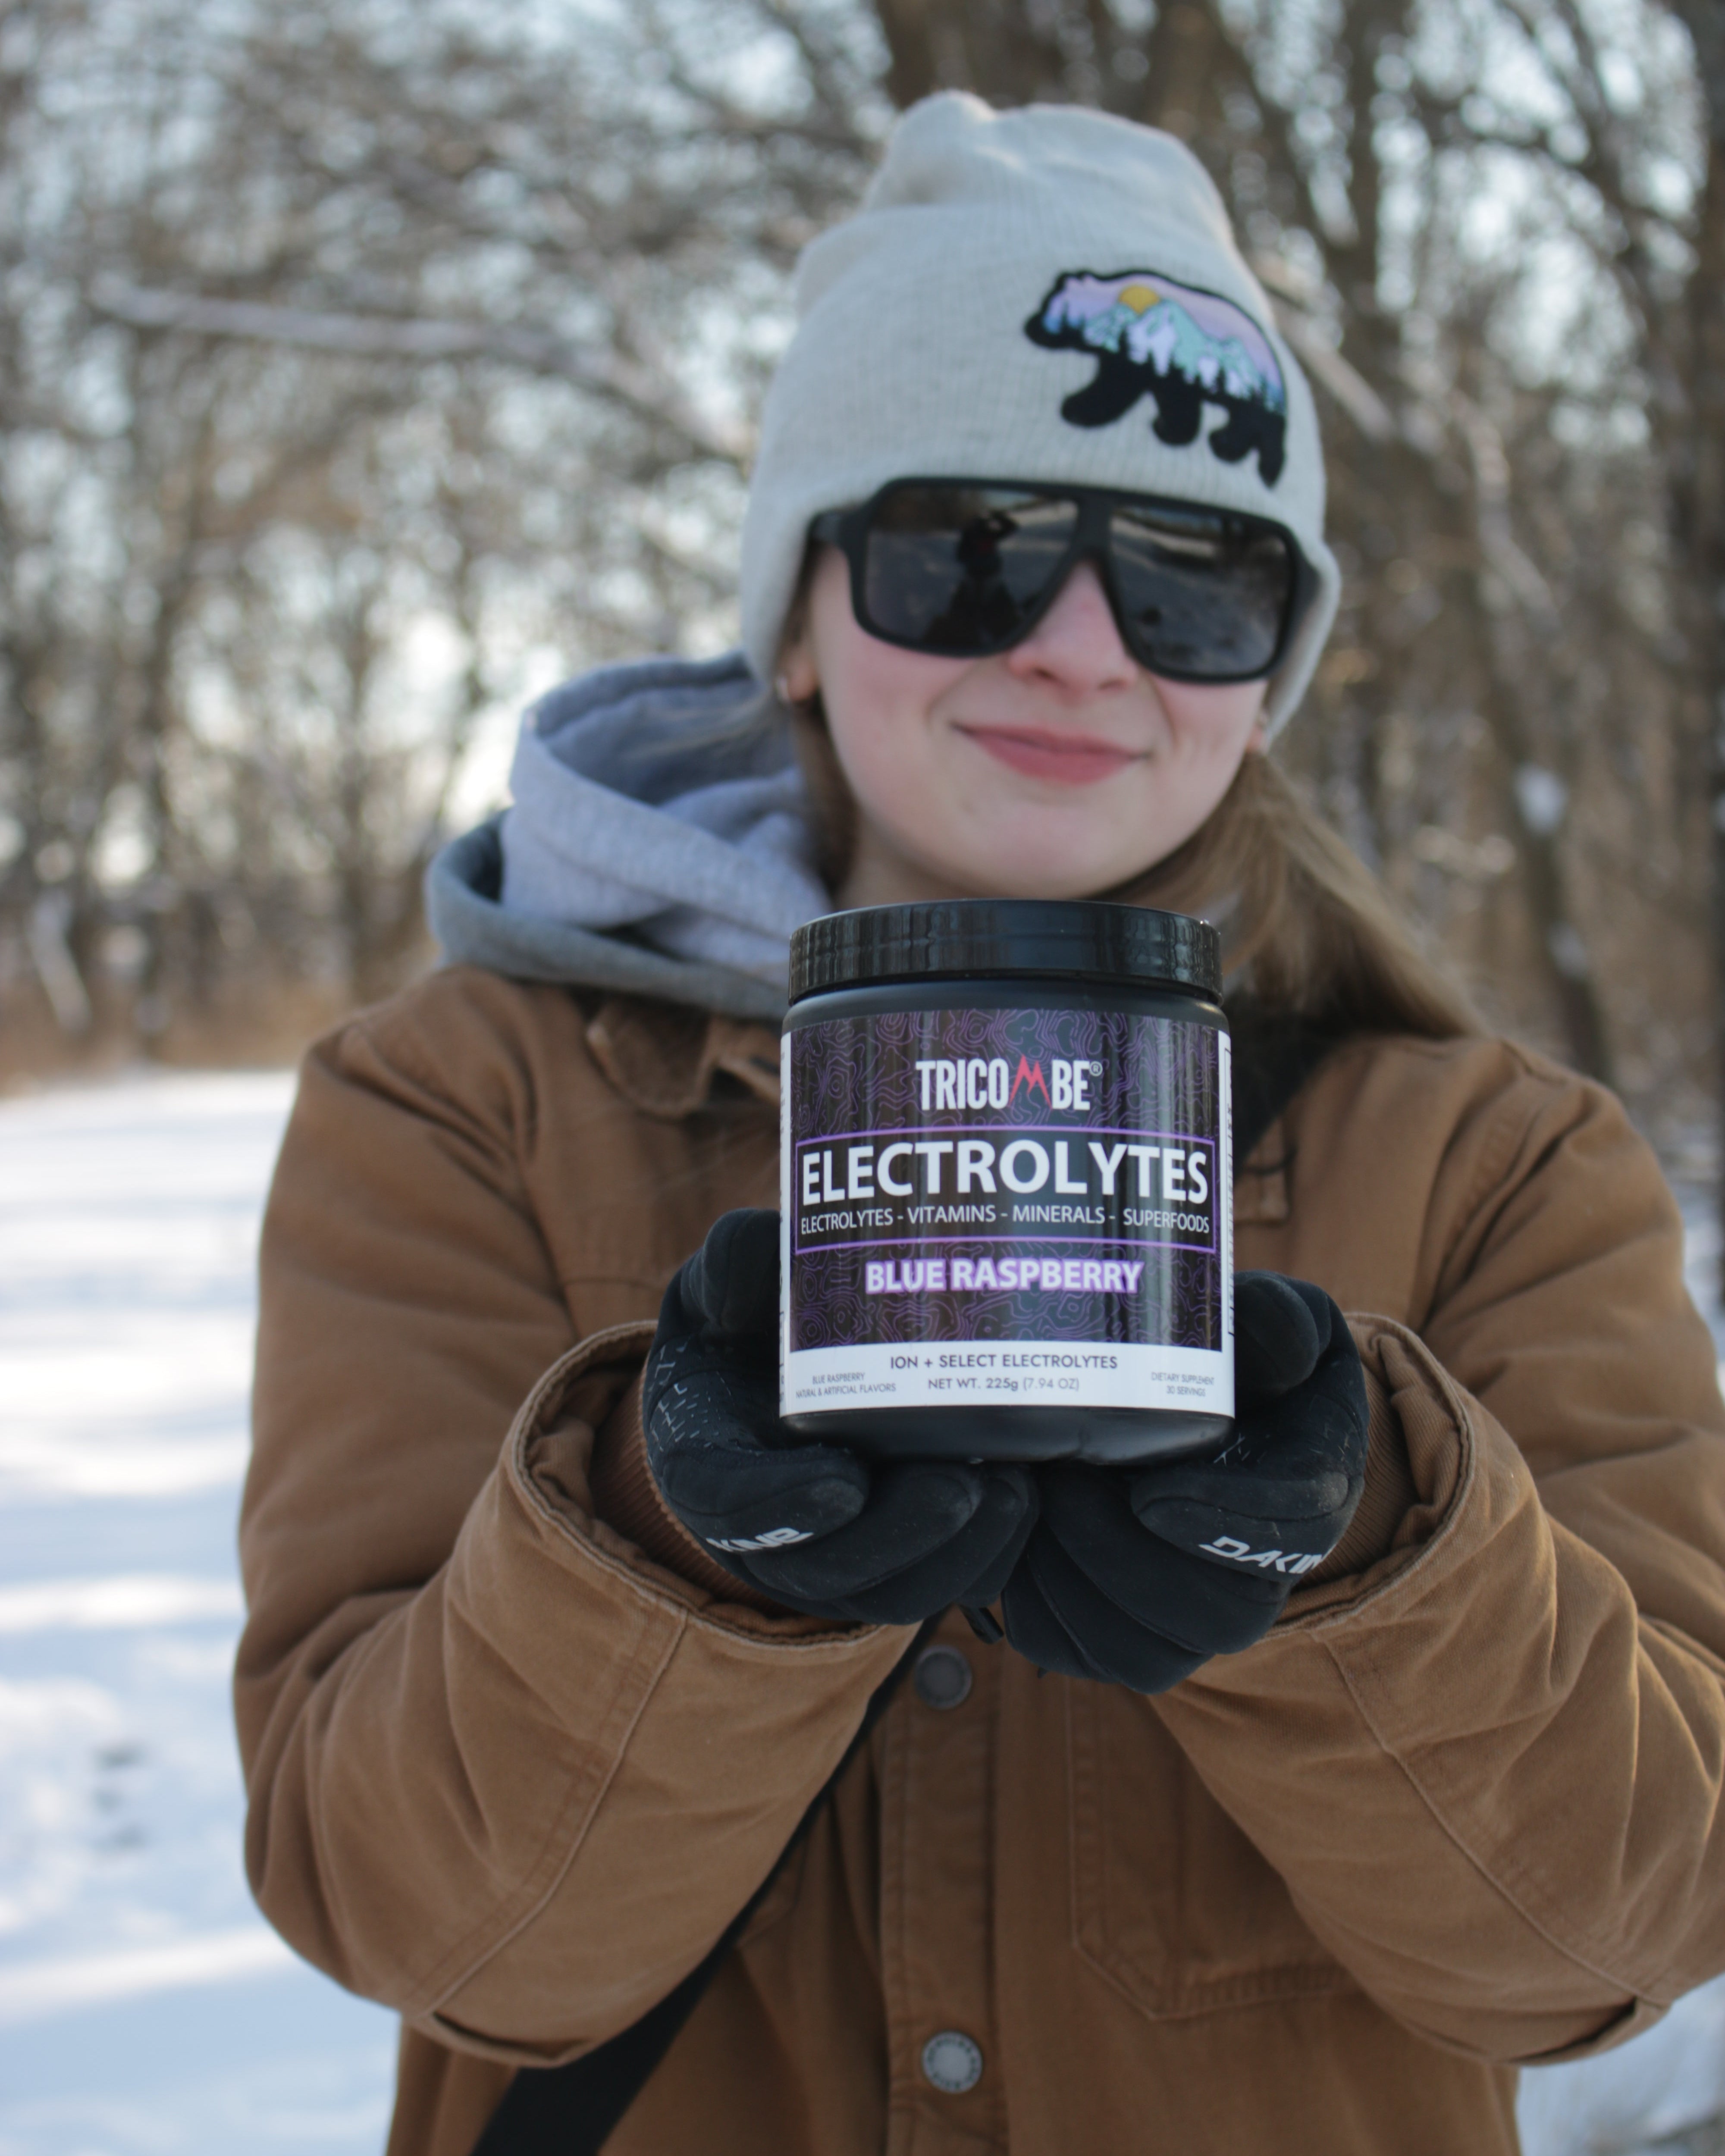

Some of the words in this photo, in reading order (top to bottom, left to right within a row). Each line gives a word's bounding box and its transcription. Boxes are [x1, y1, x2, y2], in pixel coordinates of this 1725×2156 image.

[803, 1139, 1208, 1206] ELECTROLYTES
[801, 1208, 893, 1235] ELECTROLYTES
[907, 1204, 997, 1224] VITAMINS
[1012, 1205, 1105, 1224] MINERALS
[1123, 1208, 1210, 1234] SUPERFOODS
[866, 1260, 947, 1294] BLUE
[950, 1257, 1145, 1294] RASPBERRY
[890, 1356, 918, 1369] ION
[939, 1354, 997, 1368] SELECT
[1002, 1354, 1118, 1369] ELECTROLYTES
[812, 1374, 826, 1385] BLUE
[827, 1372, 866, 1384] RASPBERRY
[928, 1378, 952, 1389] NET
[957, 1378, 981, 1389] WT.
[986, 1377, 1019, 1392] 225g
[1022, 1378, 1054, 1391] (7.94
[1058, 1378, 1080, 1392] OZ)
[1151, 1372, 1180, 1382] DIETARY
[1182, 1374, 1215, 1385] SUPPLEMENT
[796, 1389, 817, 1399] NATURAL
[824, 1385, 858, 1395] ARTIFICIAL
[859, 1383, 897, 1394] FLAVORS
[1166, 1385, 1175, 1395] 30
[1177, 1386, 1206, 1397] SERVINGS
[1198, 1536, 1324, 1575] DAKIN
